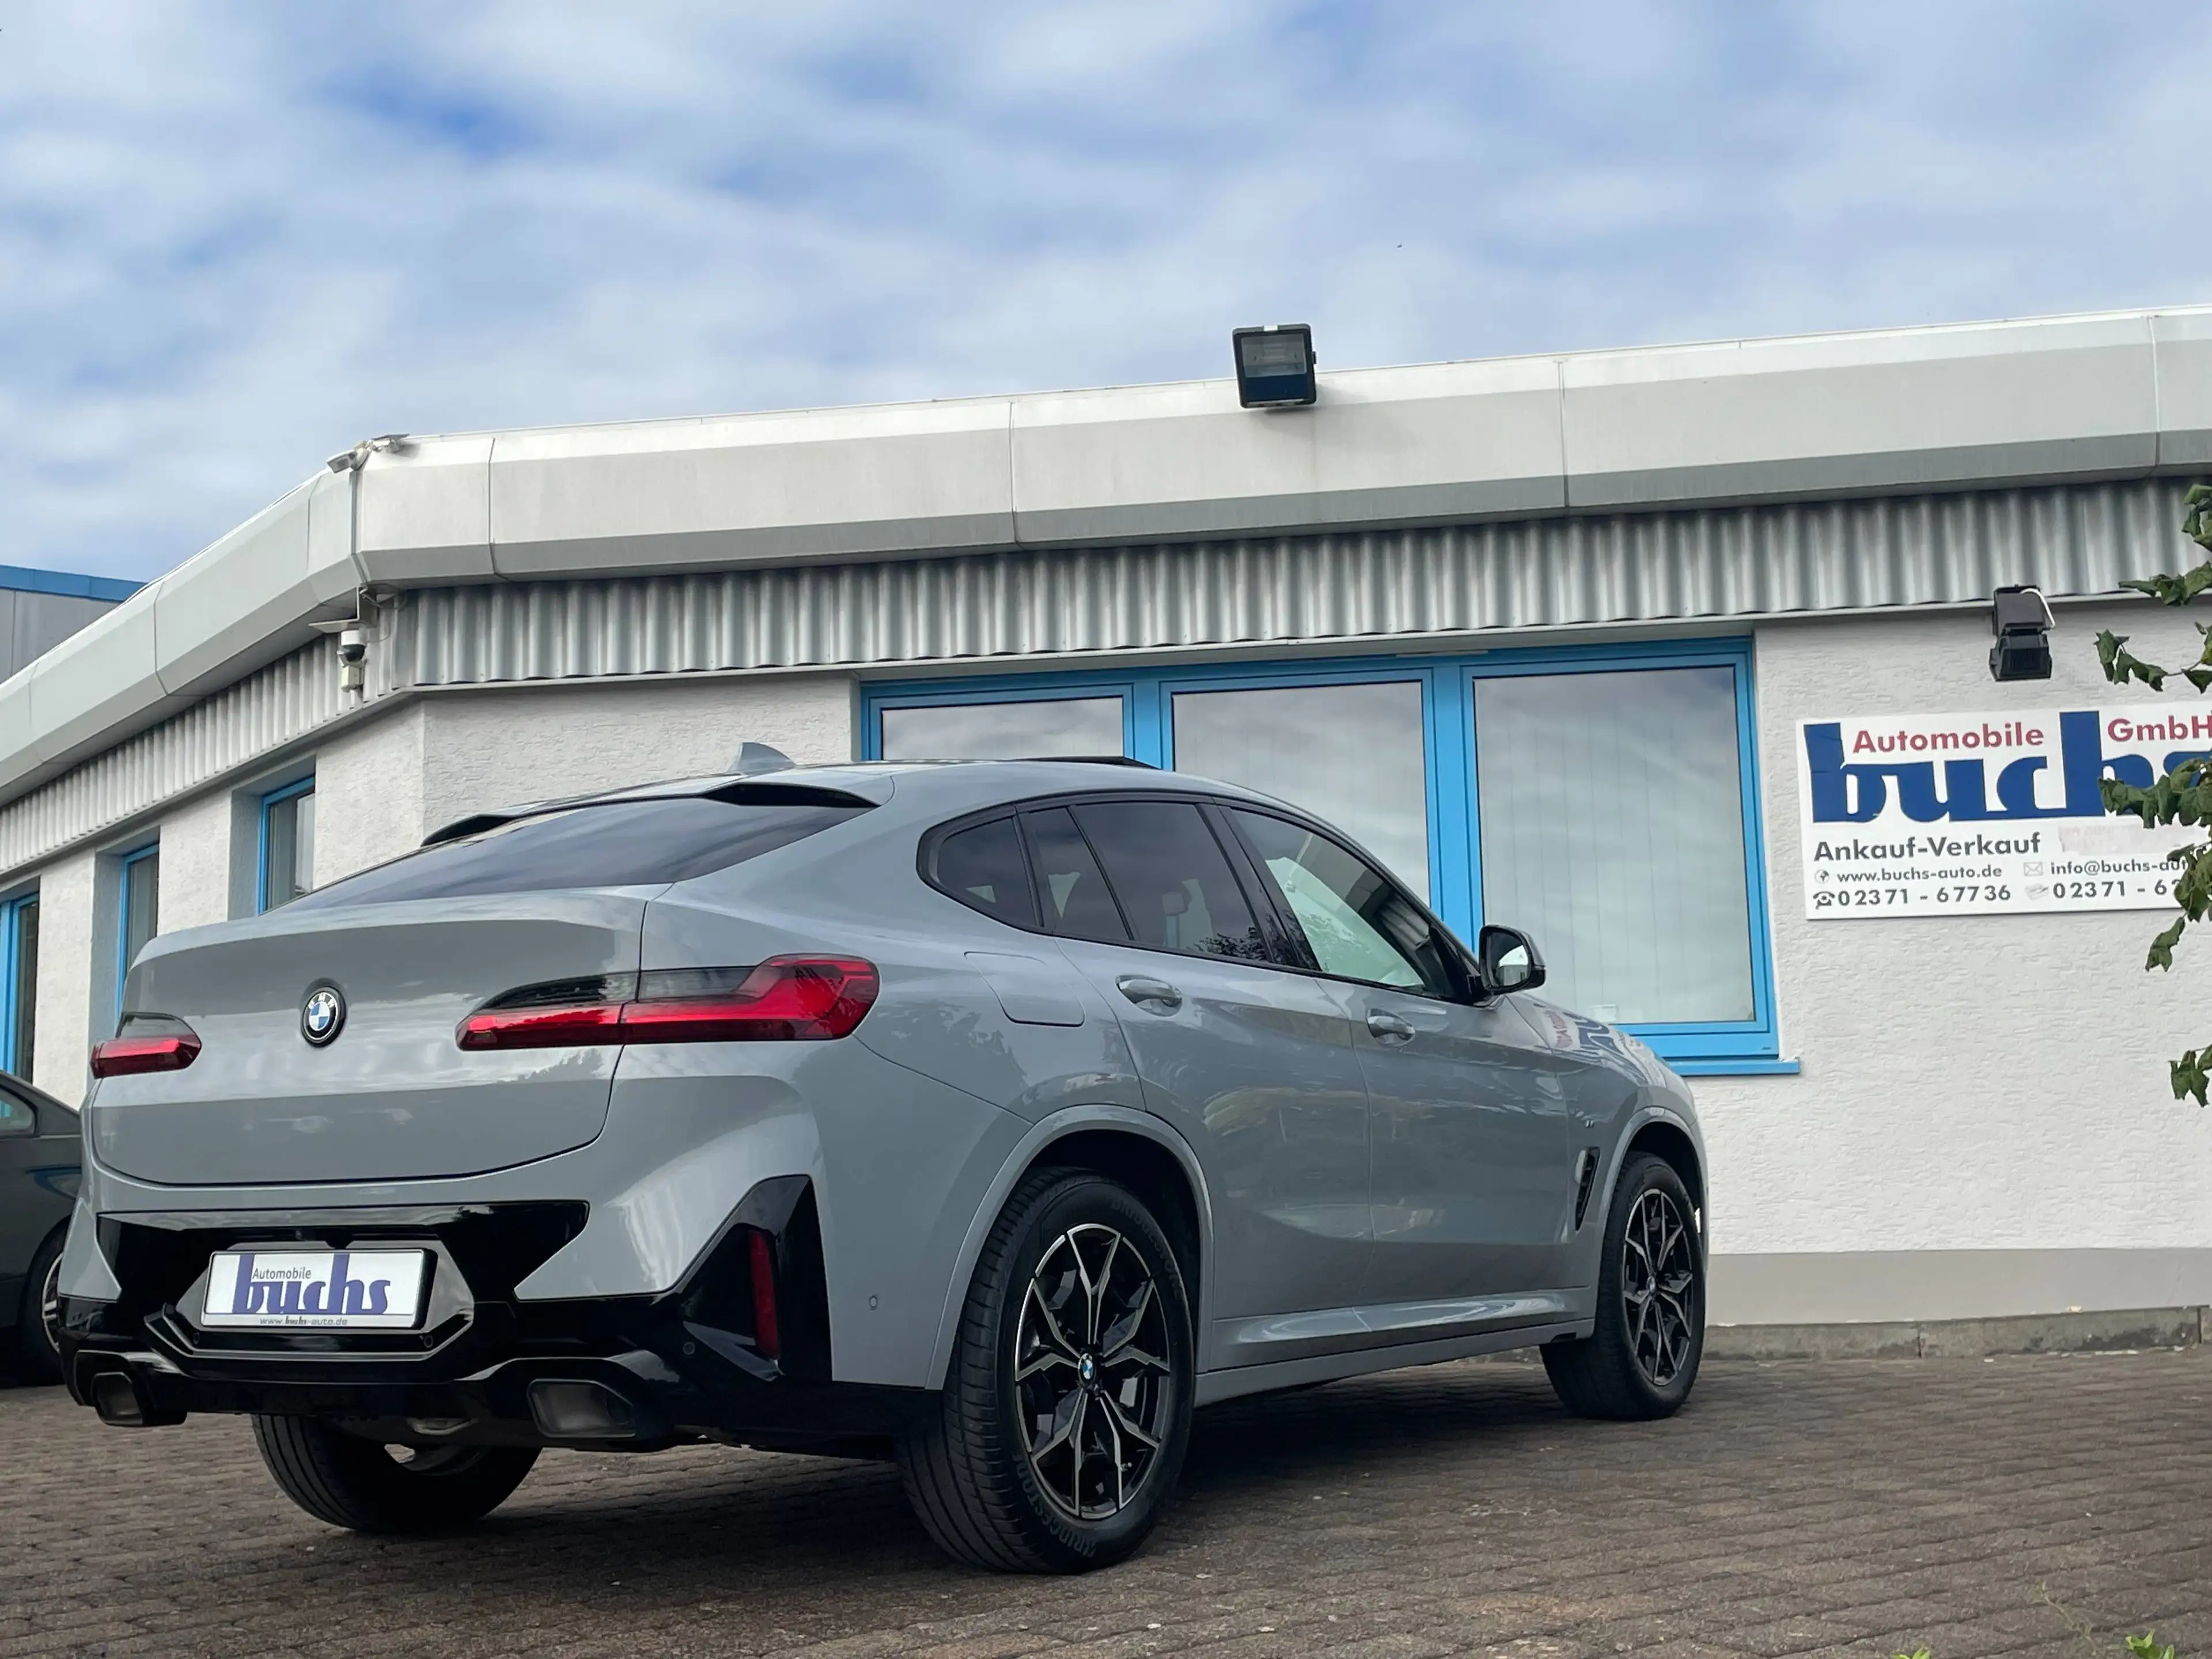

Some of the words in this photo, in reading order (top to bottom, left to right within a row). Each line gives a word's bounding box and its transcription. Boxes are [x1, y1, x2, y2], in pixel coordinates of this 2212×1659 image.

[1853, 721, 2044, 753] Automobile
[2107, 714, 2212, 742] GmbH
[1814, 831, 2041, 862] Ankauf-Verkauf
[1836, 864, 2002, 882] www.buchs-auto.de
[2051, 858, 2187, 876] info@buchs-aut
[1838, 888, 1908, 907] 02371
[1937, 885, 2011, 903] 67736
[2052, 880, 2126, 899] 02371
[252, 1266, 312, 1279] Automobile
[232, 1253, 391, 1315] buchs
[260, 1316, 347, 1325] www.buchs-auto.de
